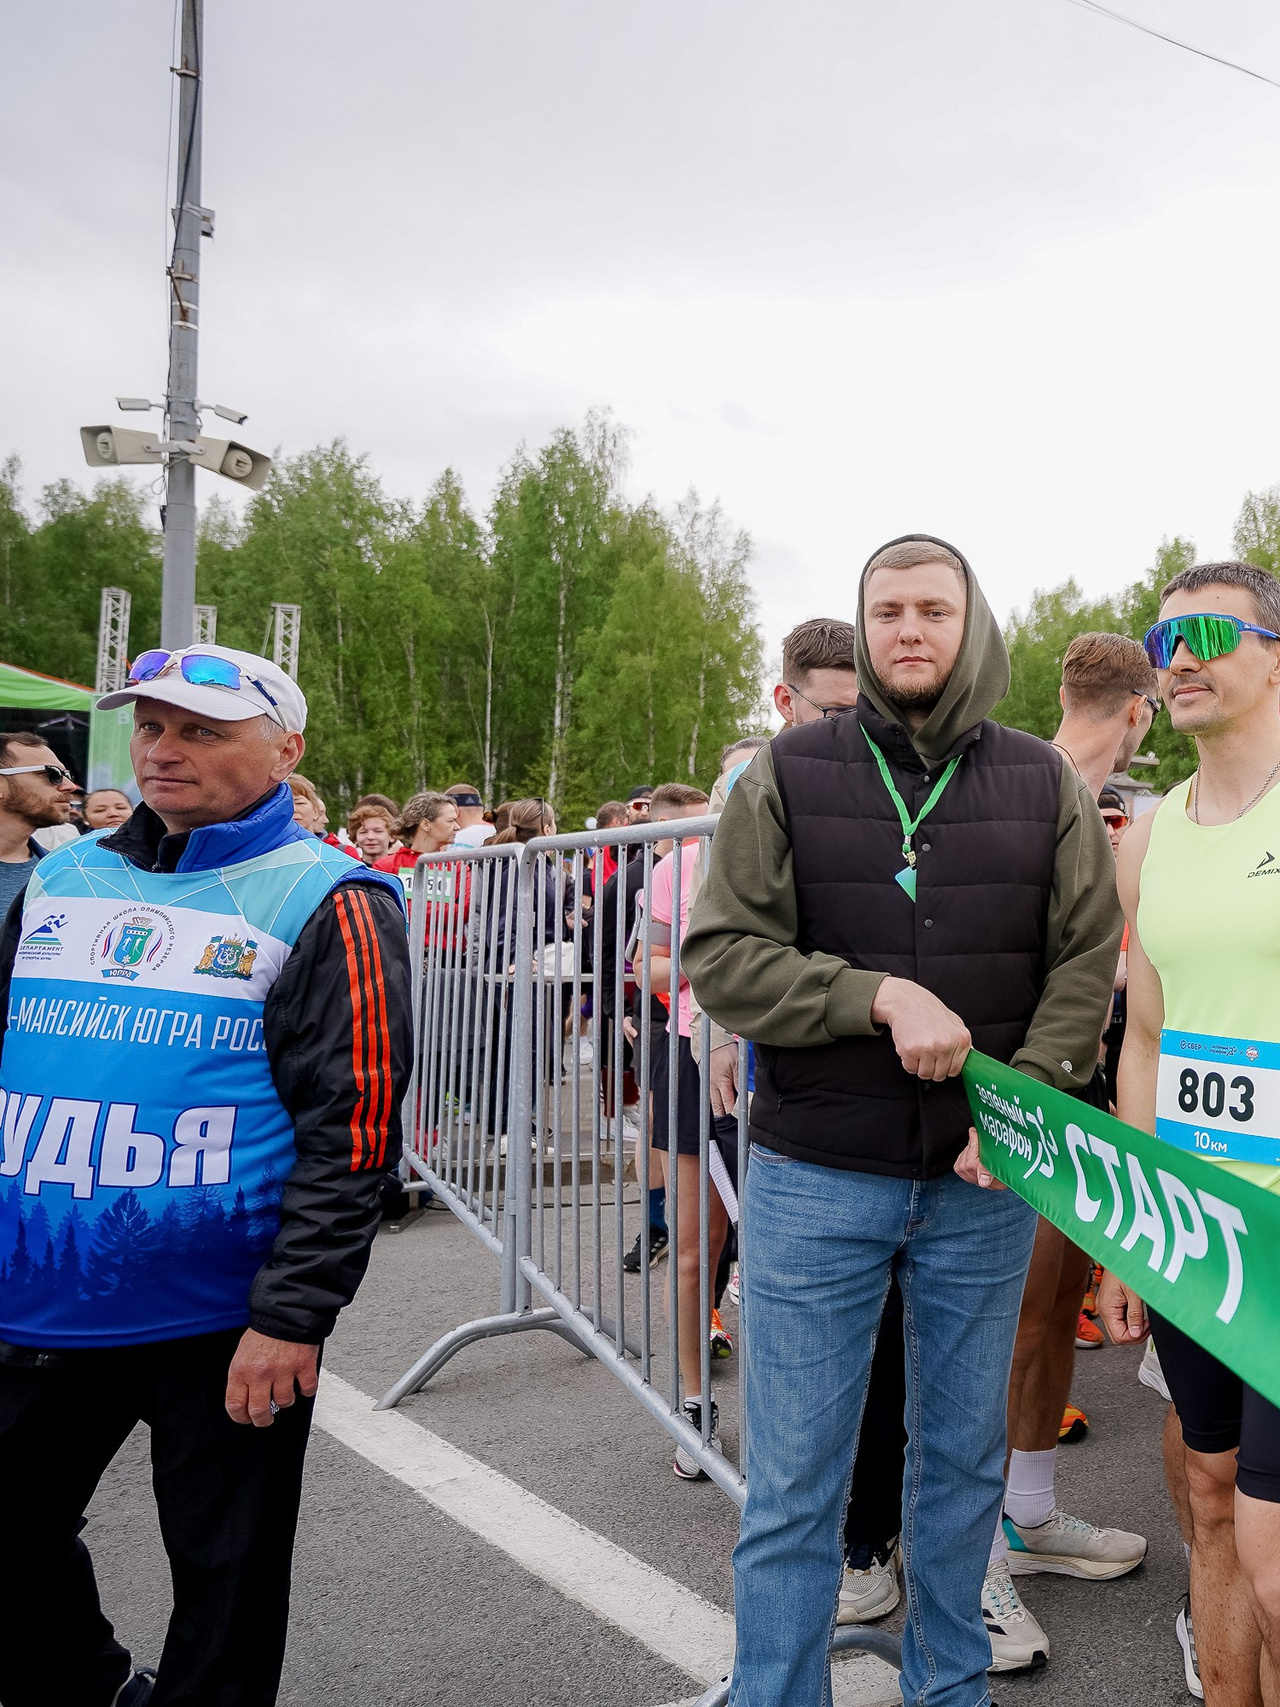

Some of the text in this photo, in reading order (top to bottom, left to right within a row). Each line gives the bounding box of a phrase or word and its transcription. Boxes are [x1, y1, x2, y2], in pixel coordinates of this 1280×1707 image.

[9, 995, 267, 1052] -МАНСИЙСК ЮГРА РОС
[1178, 1068, 1255, 1122] 803
[0, 1087, 239, 1200] УДЬЯ
[979, 1110, 1033, 1162] марафон
[1065, 1123, 1249, 1325] СТАРТ
